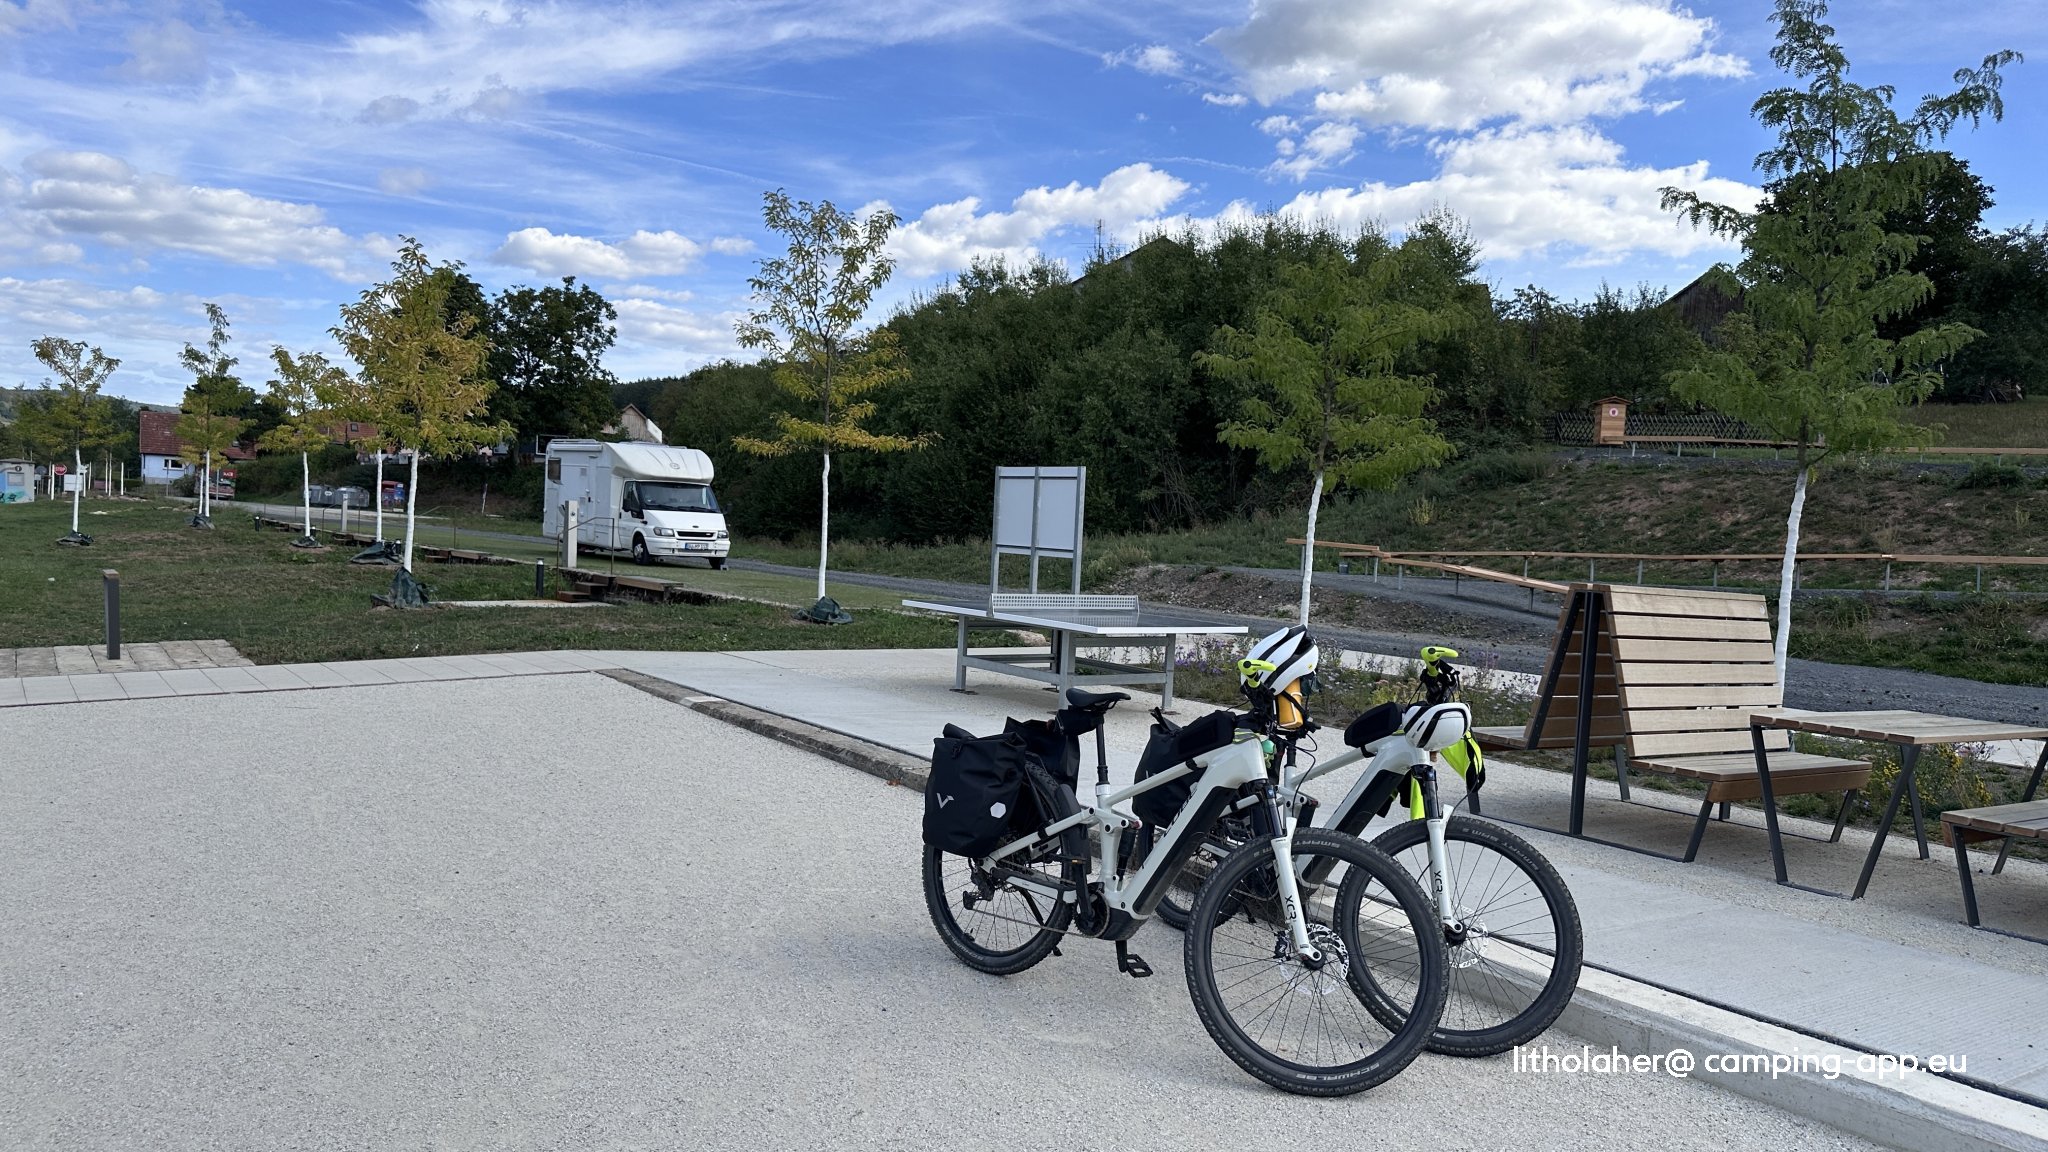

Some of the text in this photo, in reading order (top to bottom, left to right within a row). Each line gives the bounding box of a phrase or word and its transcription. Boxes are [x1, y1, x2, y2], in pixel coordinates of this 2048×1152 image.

[1293, 839, 1341, 849] SMART
[1433, 870, 1443, 894] XCR
[1295, 1062, 1380, 1081] SCHWALBE
